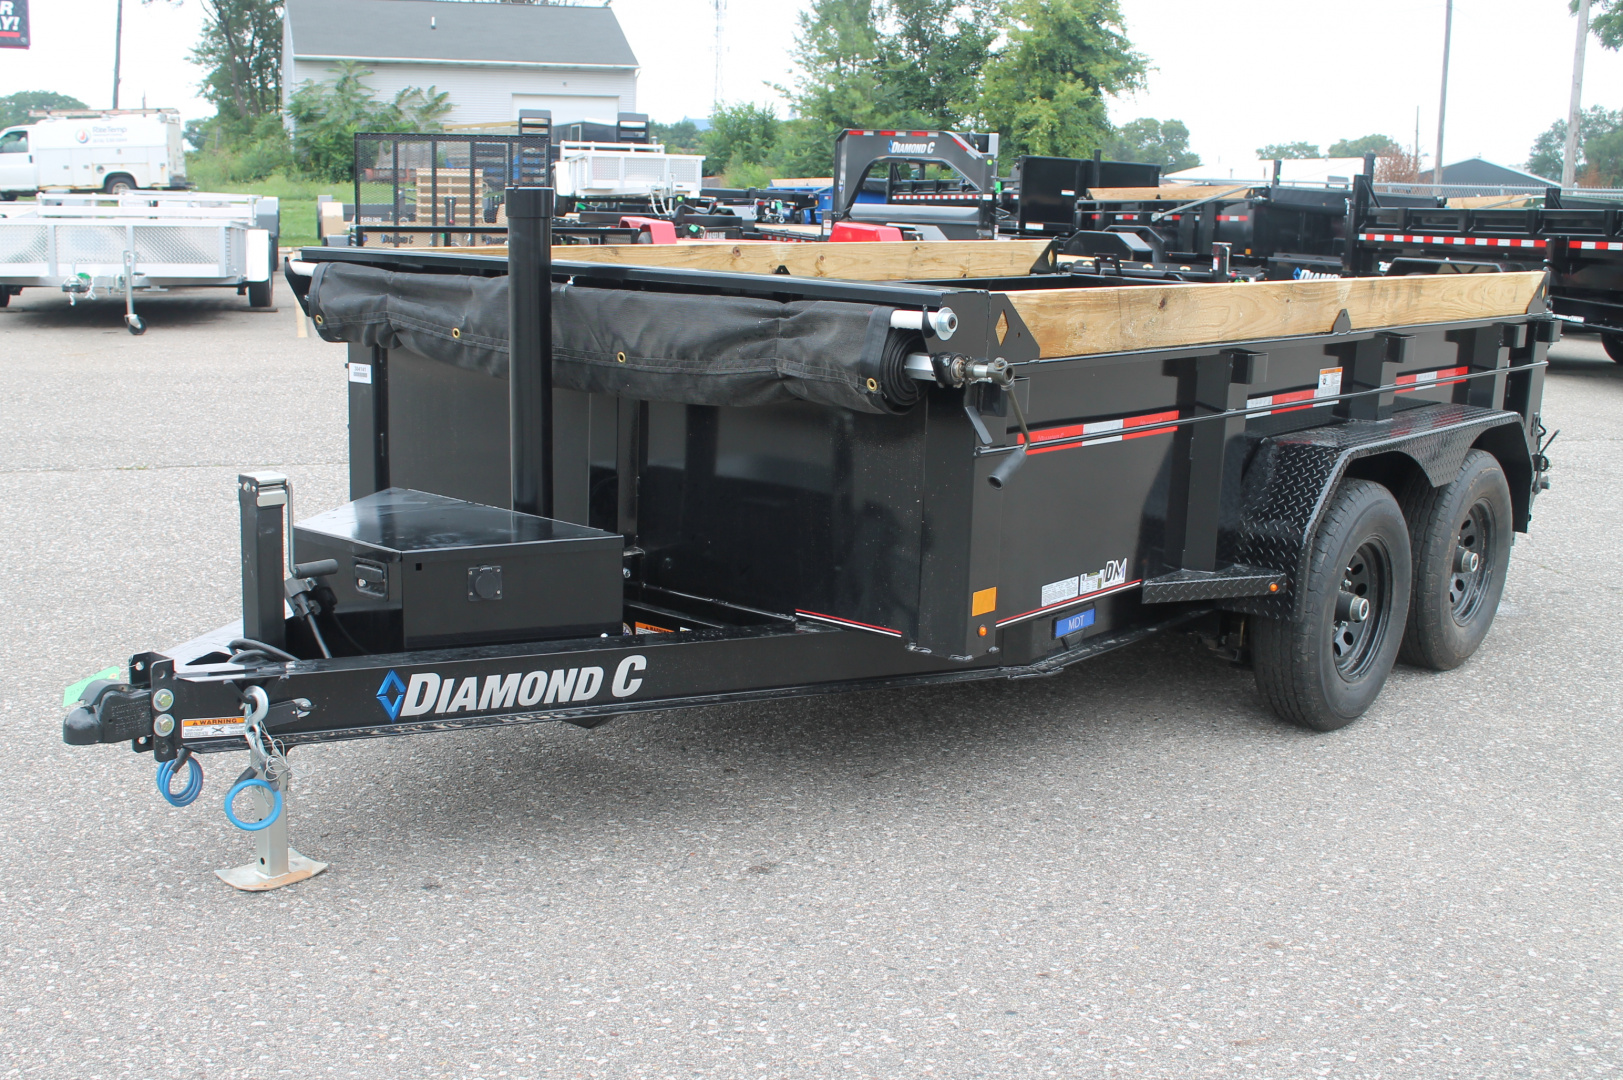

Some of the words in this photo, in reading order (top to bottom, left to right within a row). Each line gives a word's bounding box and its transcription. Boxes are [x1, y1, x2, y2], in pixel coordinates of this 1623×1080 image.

[891, 141, 927, 154] DIAMOND
[927, 141, 936, 154] C
[1299, 269, 1342, 280] DIAMO
[1104, 557, 1128, 583] DM
[1068, 615, 1085, 631] MDT
[400, 666, 604, 717] DIAMOND
[611, 655, 647, 698] C
[200, 718, 238, 726] WARNING
